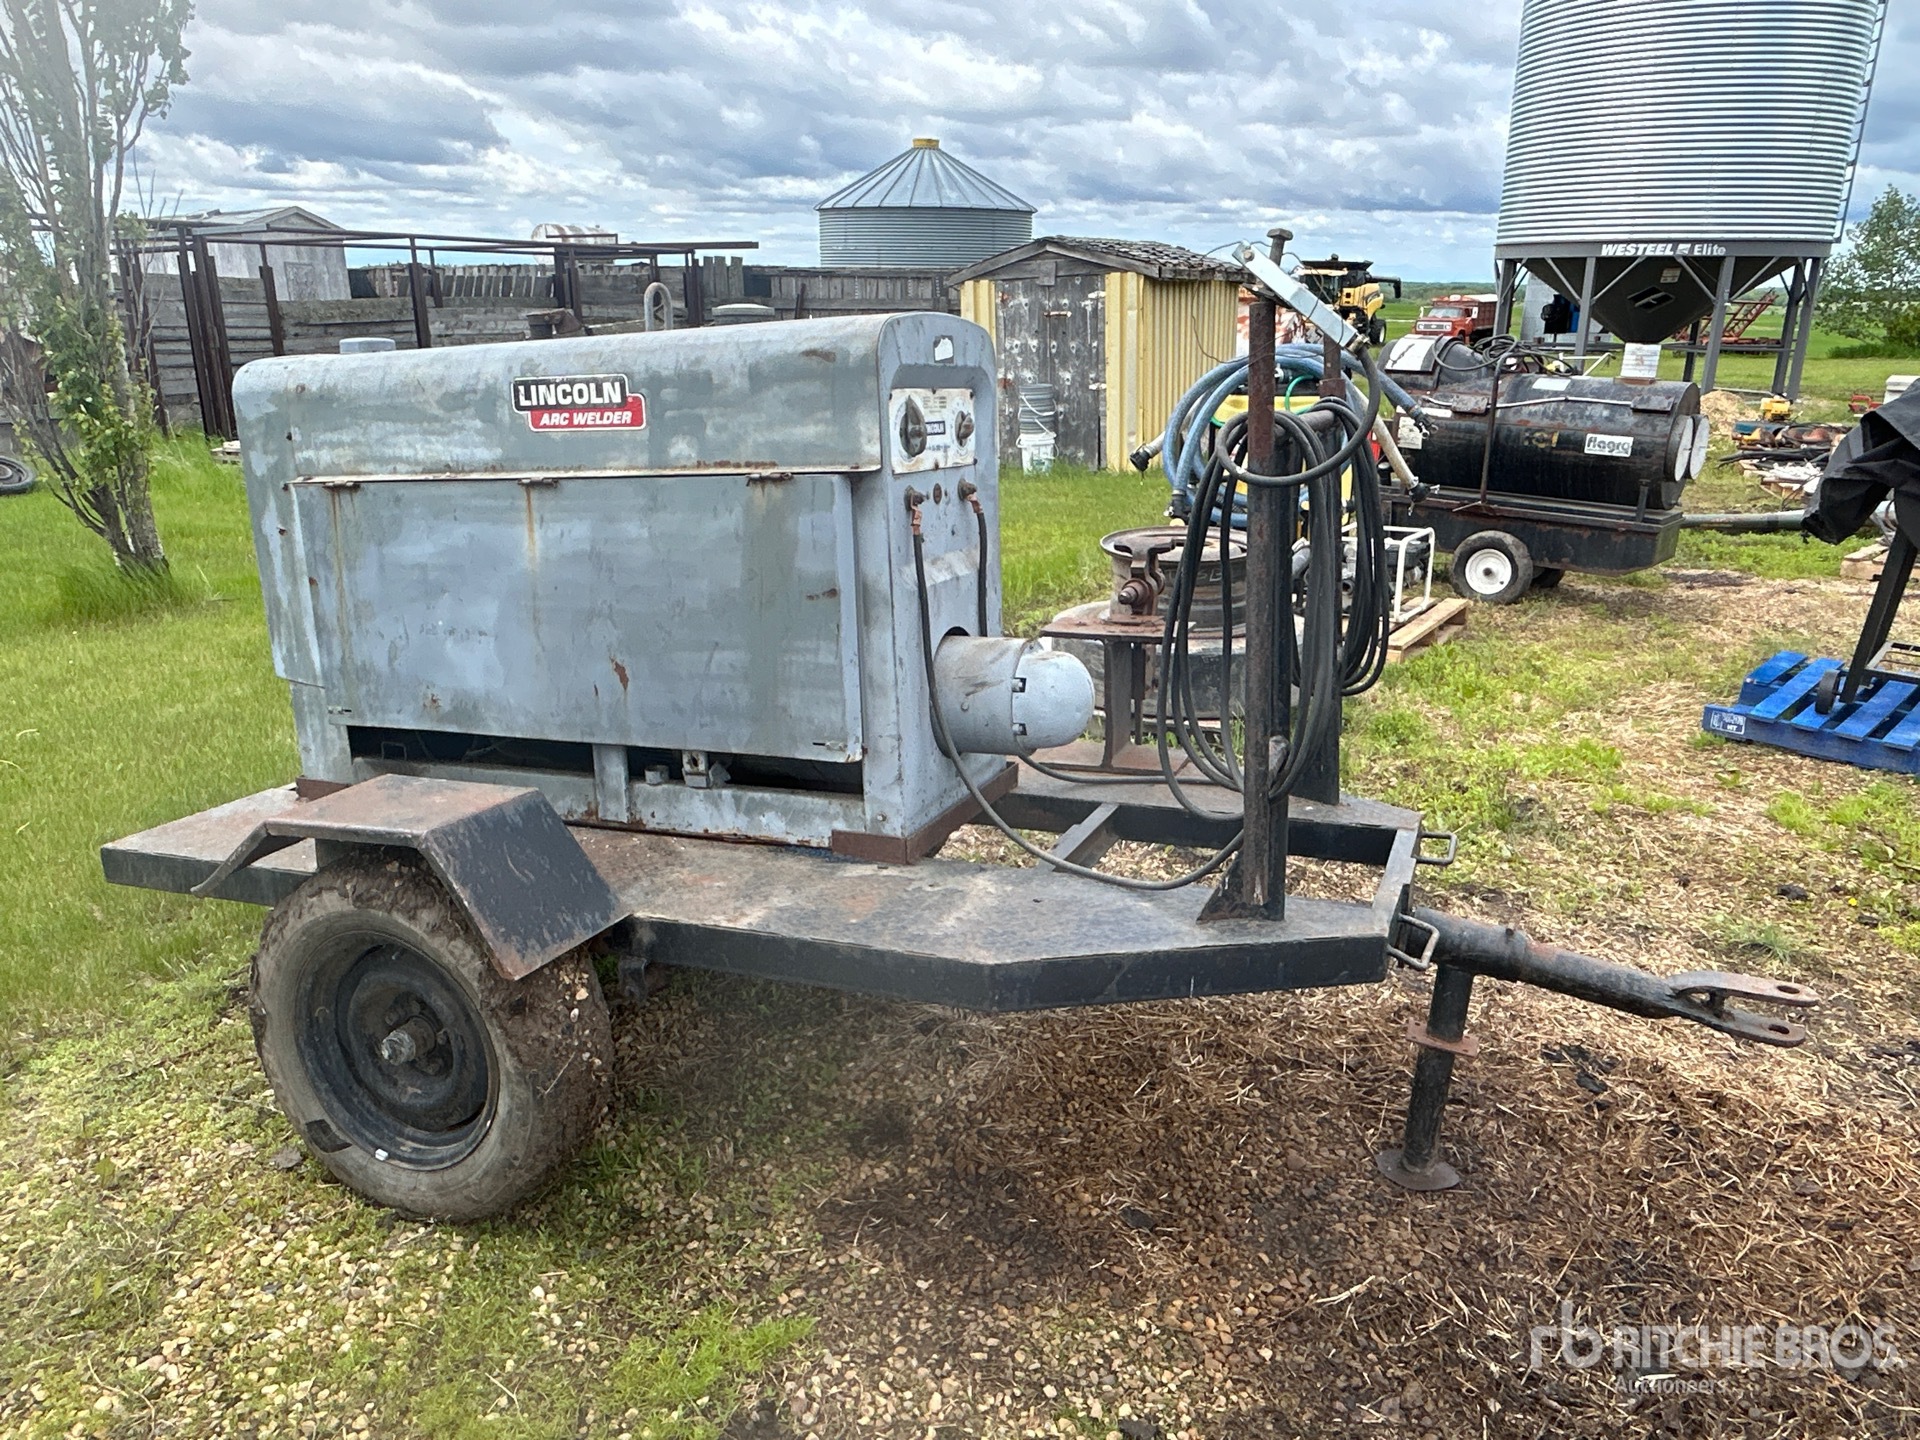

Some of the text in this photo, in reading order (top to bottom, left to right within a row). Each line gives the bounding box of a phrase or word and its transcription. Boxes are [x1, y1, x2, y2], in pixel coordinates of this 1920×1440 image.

[1601, 243, 1726, 256] WESTEEL Elite
[518, 381, 622, 406] LINCOLN
[540, 411, 632, 426] ARC WELDER
